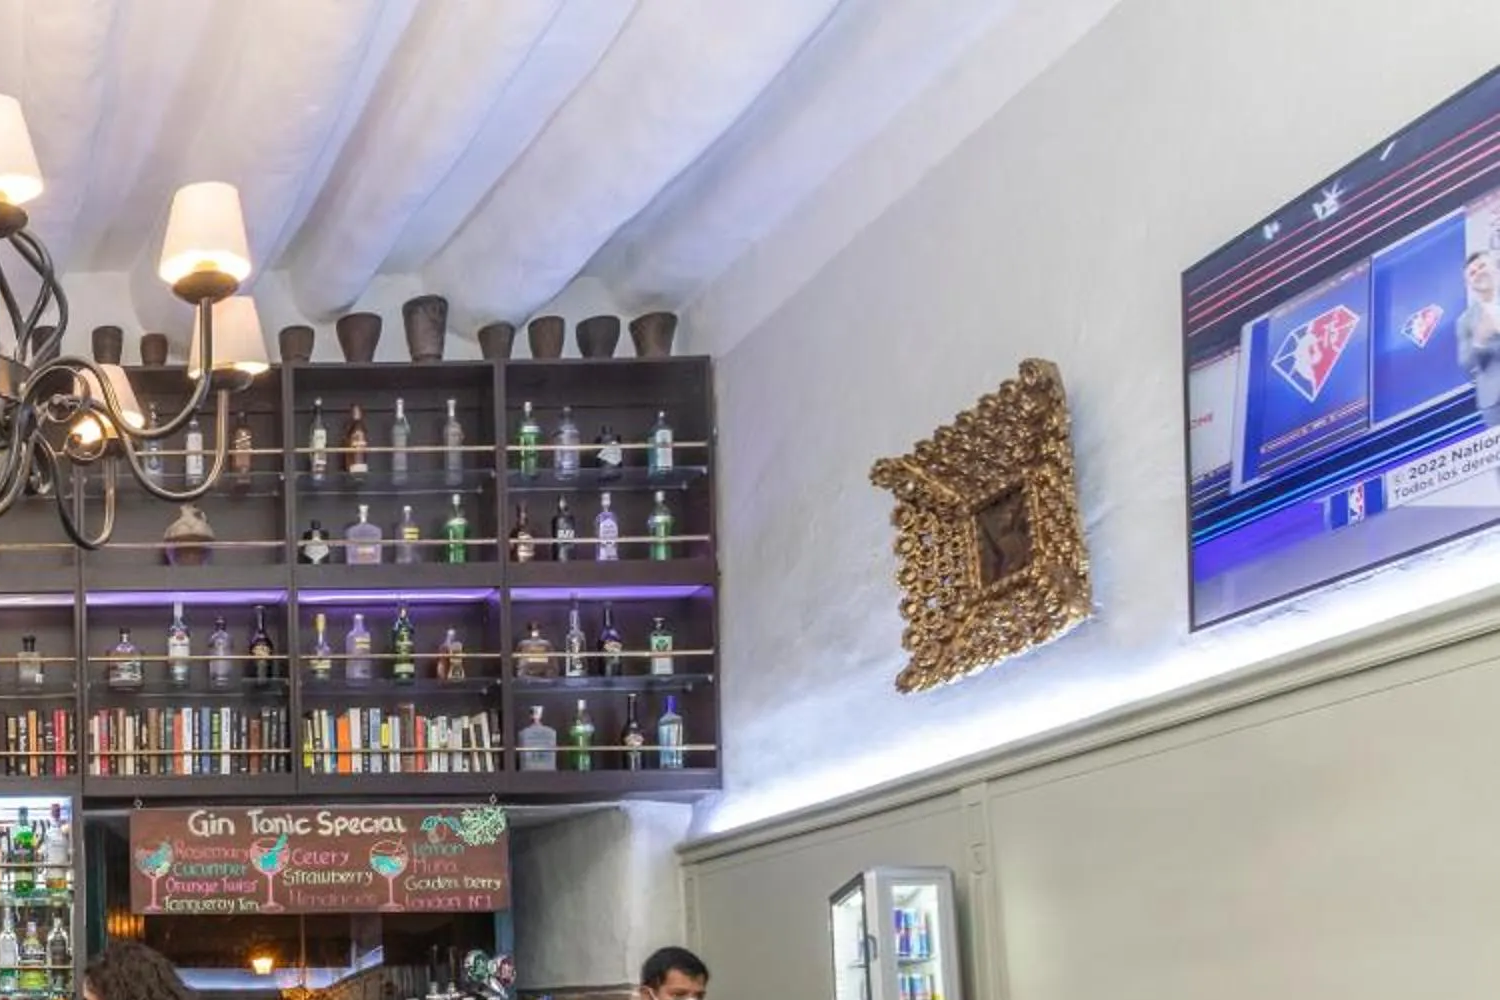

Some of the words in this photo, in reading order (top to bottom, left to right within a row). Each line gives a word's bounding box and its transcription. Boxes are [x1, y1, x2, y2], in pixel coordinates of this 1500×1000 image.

[1408, 455, 1447, 480] 2022
[187, 810, 236, 838] Gin
[247, 809, 312, 836] Tonic
[316, 811, 408, 837] Special
[291, 848, 350, 866] Celery
[165, 877, 219, 896] Orange
[282, 867, 374, 887] Strawberry
